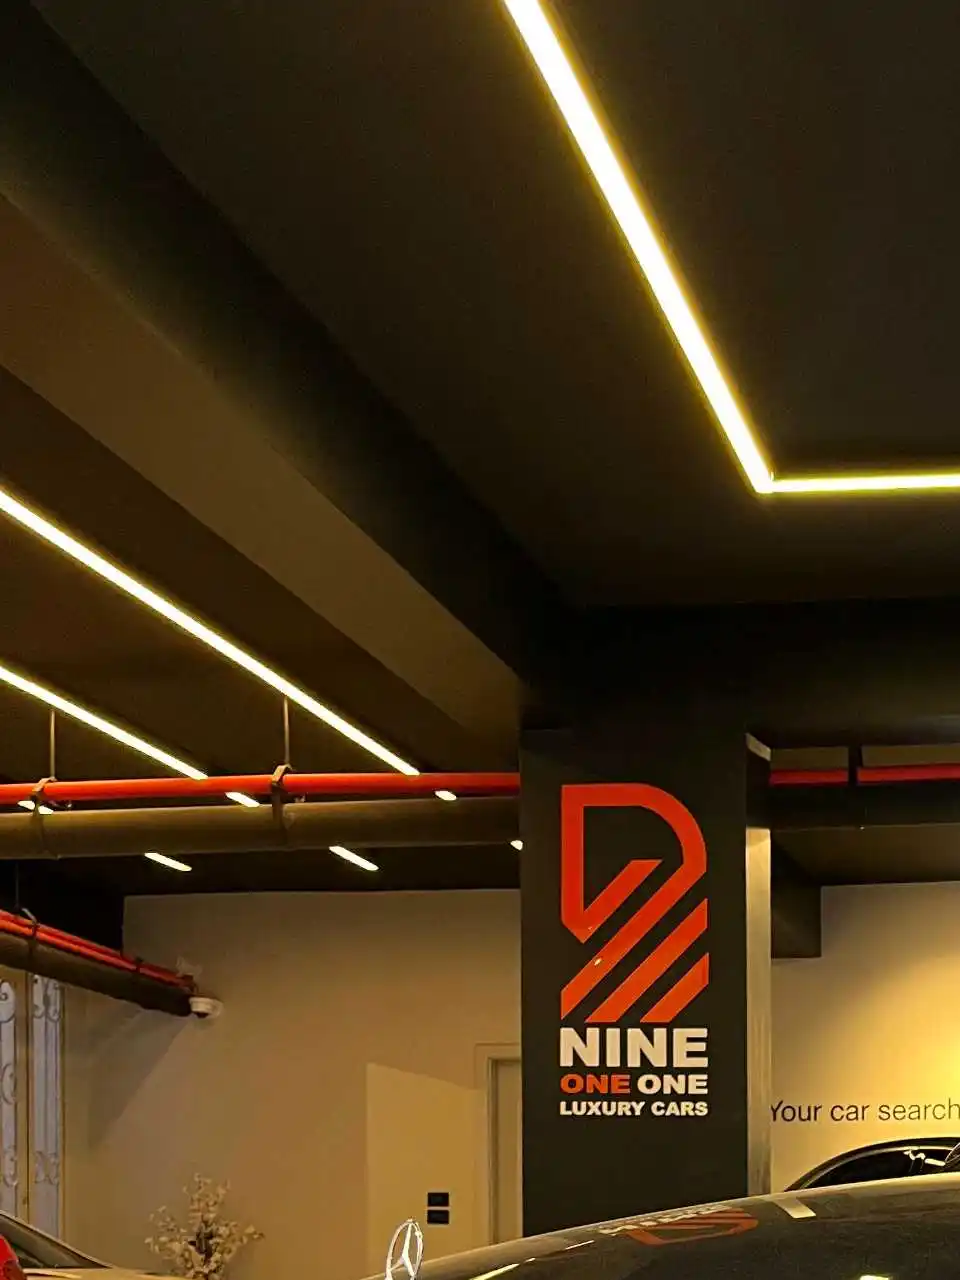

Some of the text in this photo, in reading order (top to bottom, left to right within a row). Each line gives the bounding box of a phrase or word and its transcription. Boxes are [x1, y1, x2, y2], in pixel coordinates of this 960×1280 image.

[560, 1027, 708, 1068] NINE
[560, 1073, 708, 1095] ONE ONE
[560, 1101, 708, 1116] LUXURY CARS
[770, 1100, 822, 1122] Your
[830, 1104, 870, 1122] car
[878, 1098, 960, 1121] search
